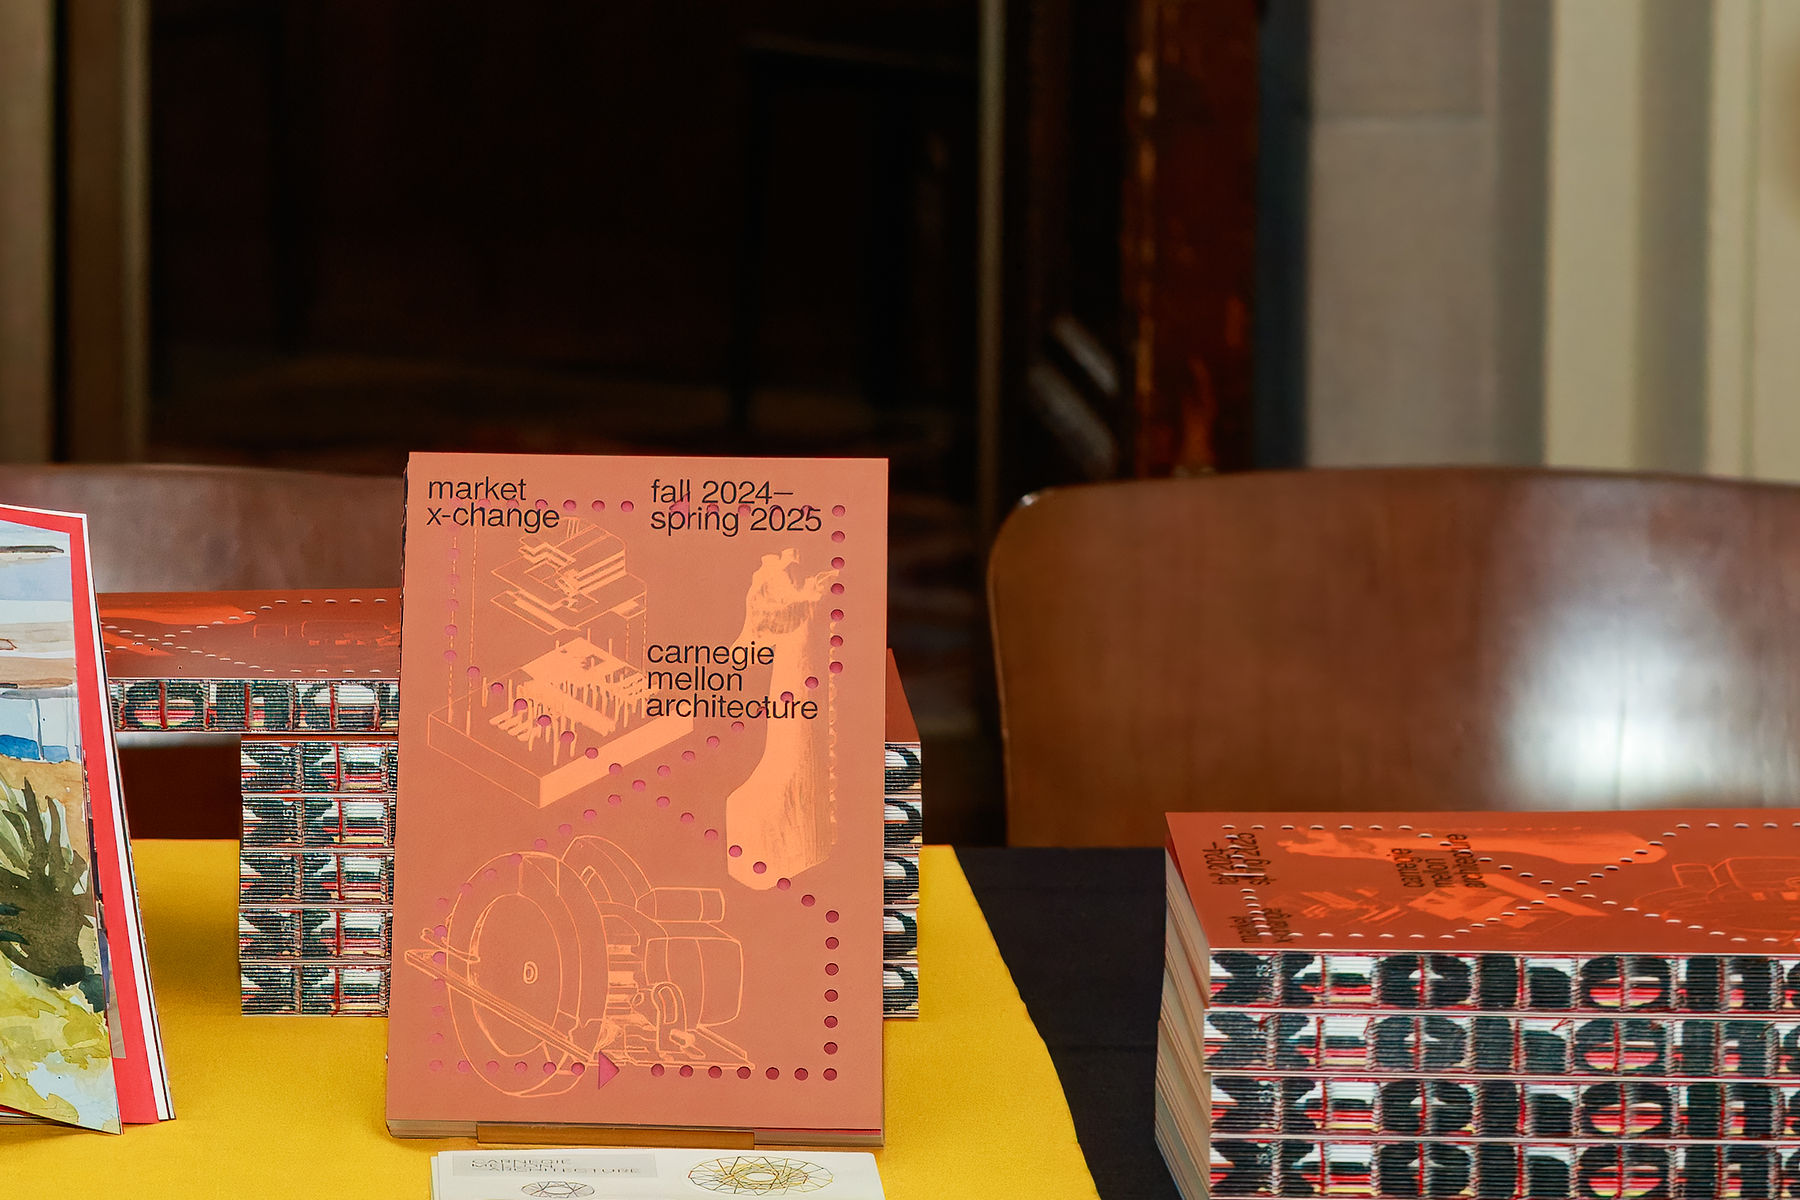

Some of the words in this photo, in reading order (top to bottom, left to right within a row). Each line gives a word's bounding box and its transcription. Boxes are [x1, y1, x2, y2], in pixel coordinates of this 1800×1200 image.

[427, 476, 528, 501] market
[650, 479, 693, 504] fall
[425, 504, 561, 534] x-change
[650, 506, 741, 537] spring
[749, 507, 823, 532] 2025
[646, 641, 775, 671] carnegie
[646, 667, 743, 691] mellon
[646, 692, 819, 720] architecture
